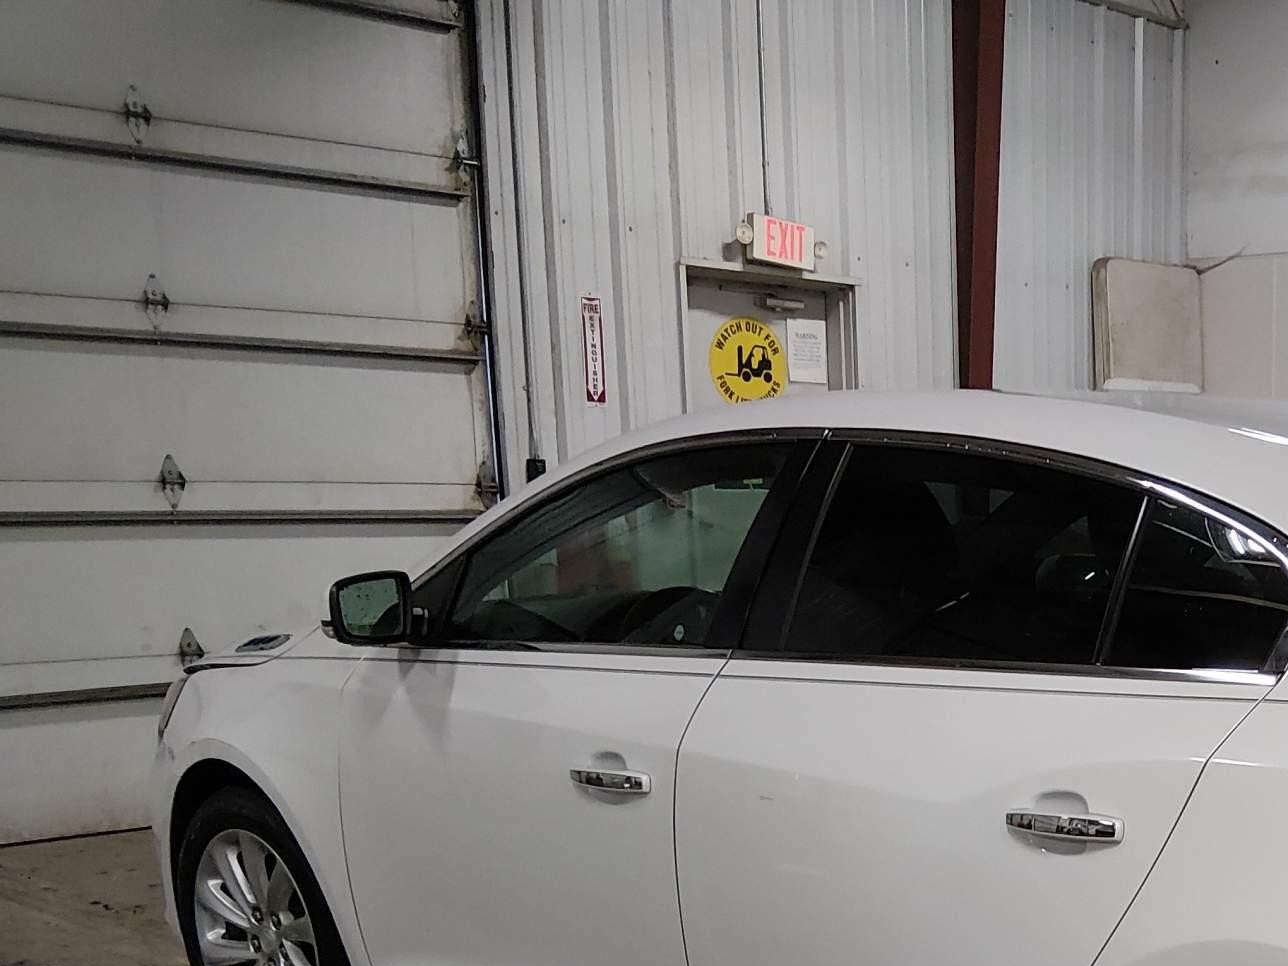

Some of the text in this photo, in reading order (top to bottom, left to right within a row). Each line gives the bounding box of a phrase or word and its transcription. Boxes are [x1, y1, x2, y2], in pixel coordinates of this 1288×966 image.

[767, 219, 805, 263] EXIT
[583, 303, 599, 314] FIRE
[589, 315, 598, 396] EXTINGUISHER
[714, 321, 743, 351] WATCH
[745, 321, 764, 337] OUT
[763, 334, 780, 356] FOR
[716, 374, 735, 401] FORK
